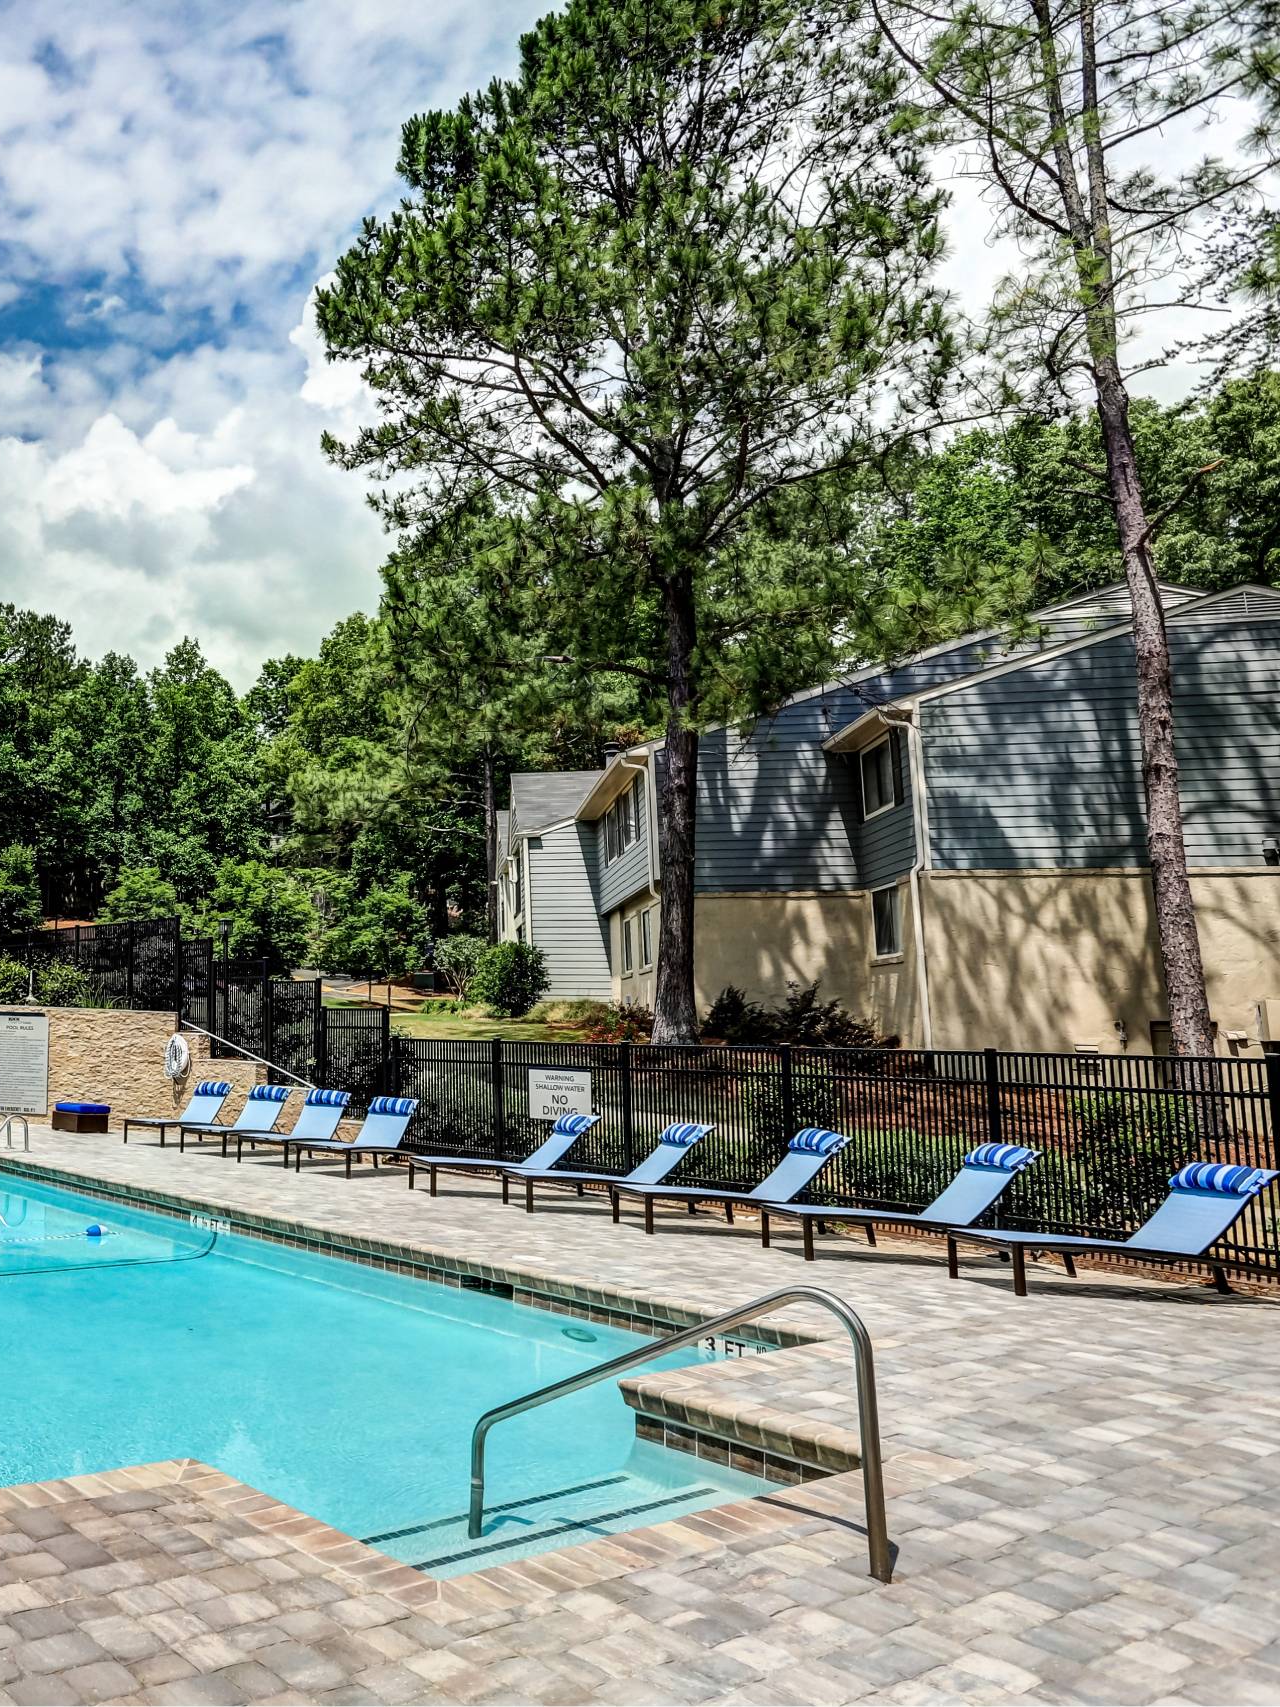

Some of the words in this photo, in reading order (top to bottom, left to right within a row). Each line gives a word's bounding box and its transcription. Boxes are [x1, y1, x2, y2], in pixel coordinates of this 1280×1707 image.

[545, 1074, 575, 1082] WARNING
[535, 1083, 564, 1091] SHALLOW
[564, 1085, 585, 1093] WATER
[551, 1094, 569, 1105] NO
[725, 1340, 746, 1357] FT
